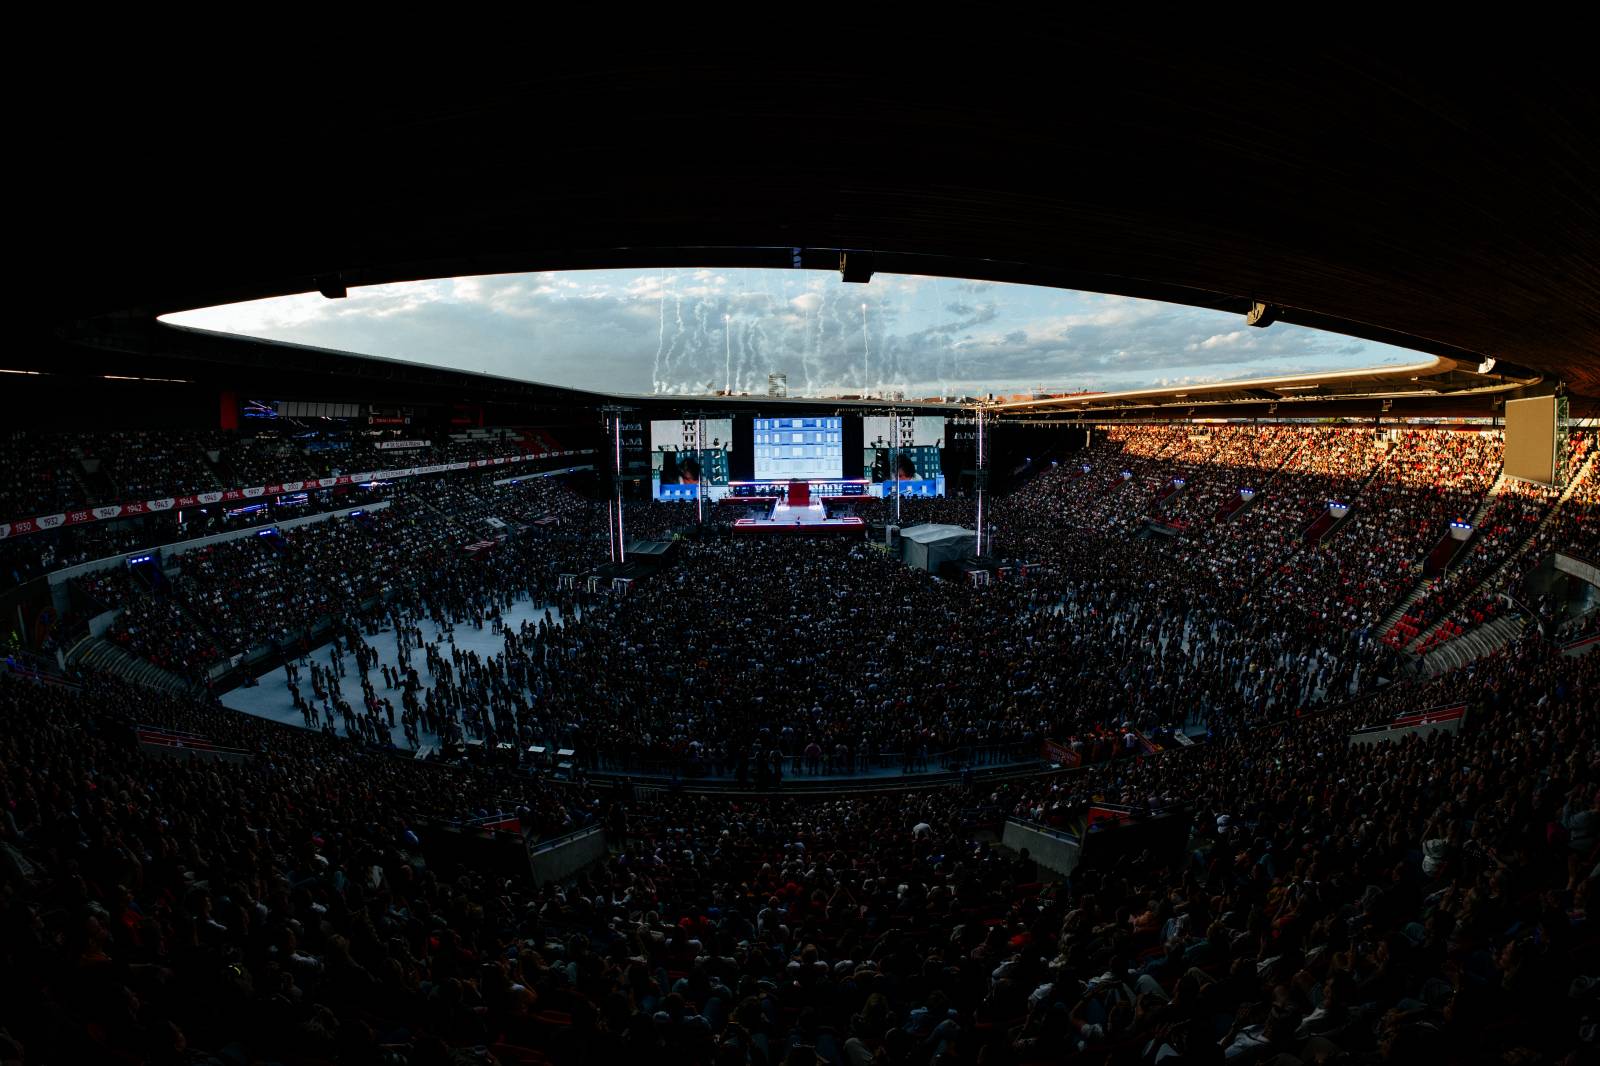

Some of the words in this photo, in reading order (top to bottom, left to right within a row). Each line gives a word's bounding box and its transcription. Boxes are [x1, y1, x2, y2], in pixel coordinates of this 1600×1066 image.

[16, 522, 31, 532] 1930
[44, 518, 58, 527] 1932
[71, 512, 88, 521] 1935
[100, 508, 114, 517] 1941
[127, 504, 142, 512] 1942
[154, 500, 168, 509] 1943
